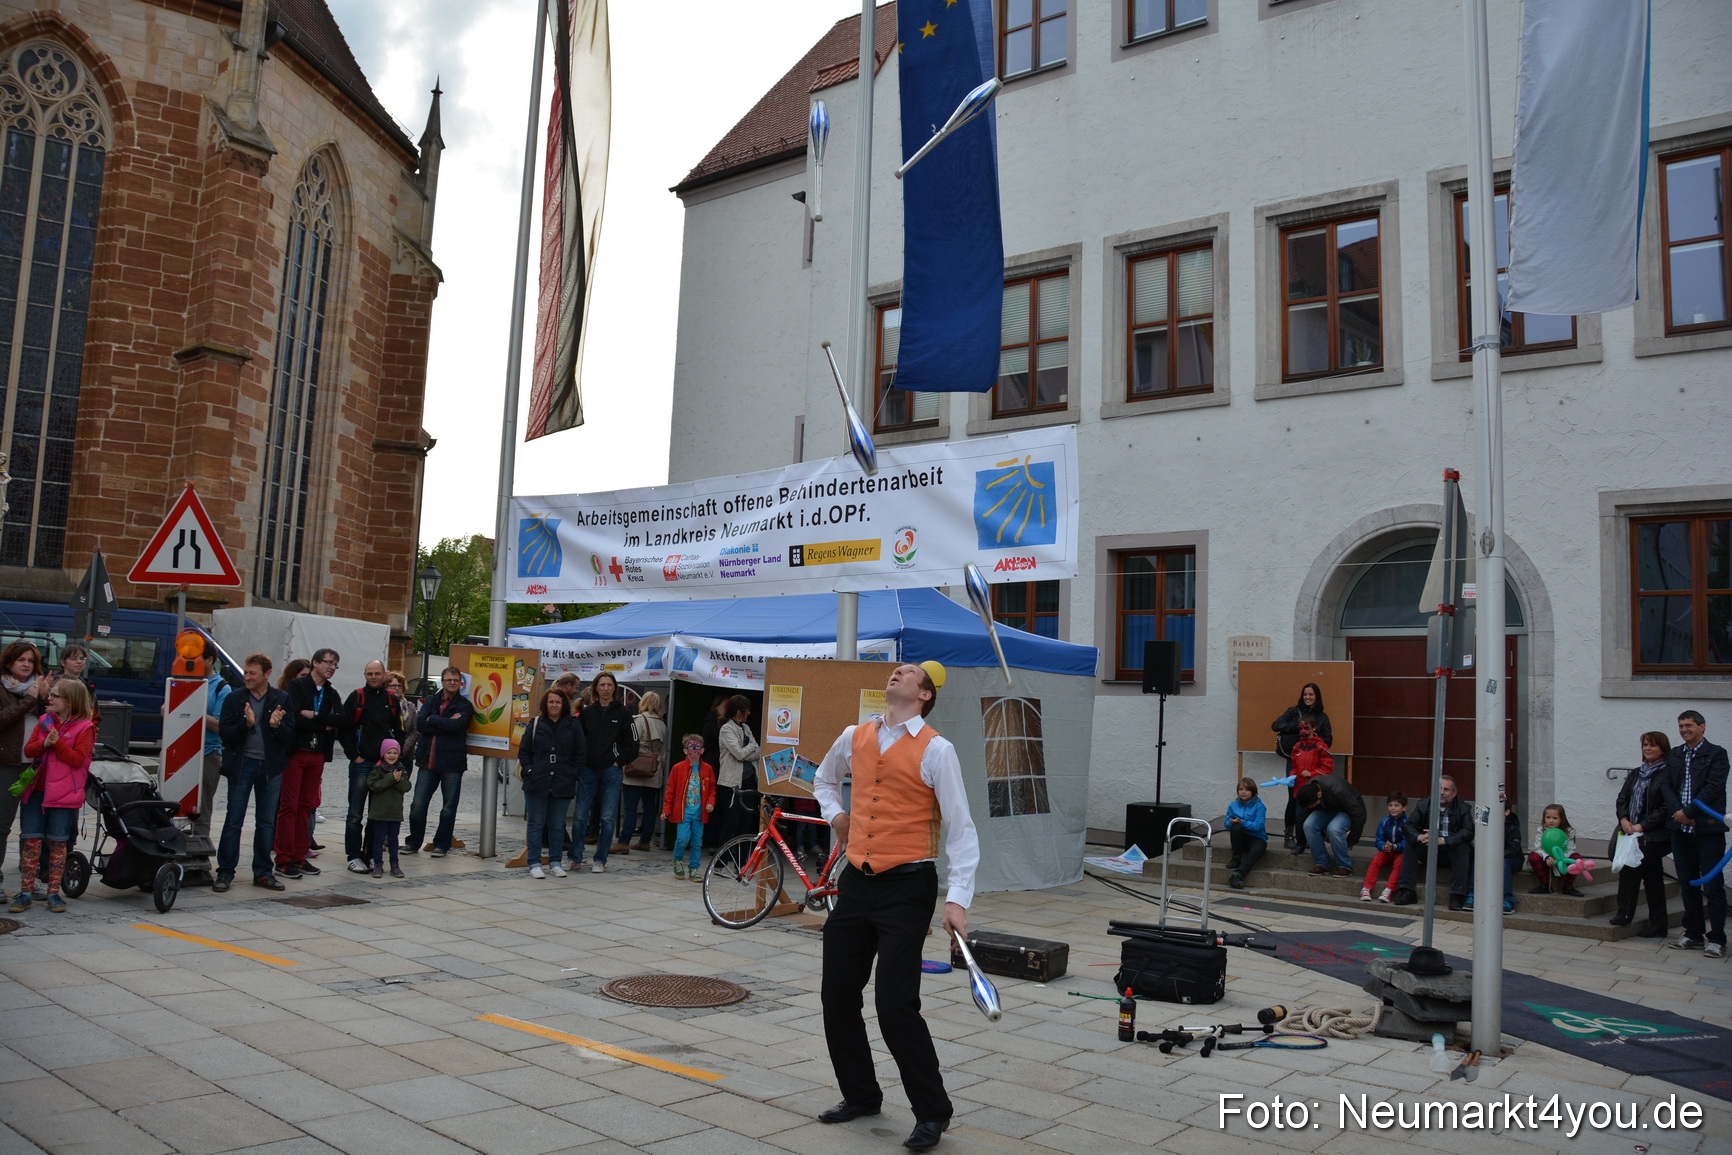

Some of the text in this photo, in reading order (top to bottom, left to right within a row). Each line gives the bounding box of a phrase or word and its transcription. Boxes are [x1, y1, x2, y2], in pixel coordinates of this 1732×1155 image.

[577, 466, 943, 528] Arbeitsgemeinschaft offene Behindertenarbeit
[623, 503, 871, 547] im Landkreis Neumarkt i.d.OPf.
[720, 545, 751, 555] Diakonie
[807, 545, 875, 562] Regens Wagner
[624, 556, 663, 565] Bayerisches
[719, 554, 782, 567] Nürnberger Land
[625, 565, 642, 573] Rotes
[720, 568, 756, 578] Neumarkt
[627, 574, 645, 582] Kreuz
[677, 571, 703, 580] Neumarkt
[552, 649, 594, 659] Mit-Mach
[597, 648, 641, 659] Angebote
[710, 651, 754, 663] Aktionen
[773, 686, 800, 694] URKUNDE
[777, 840, 806, 876] SPECIALIZED
